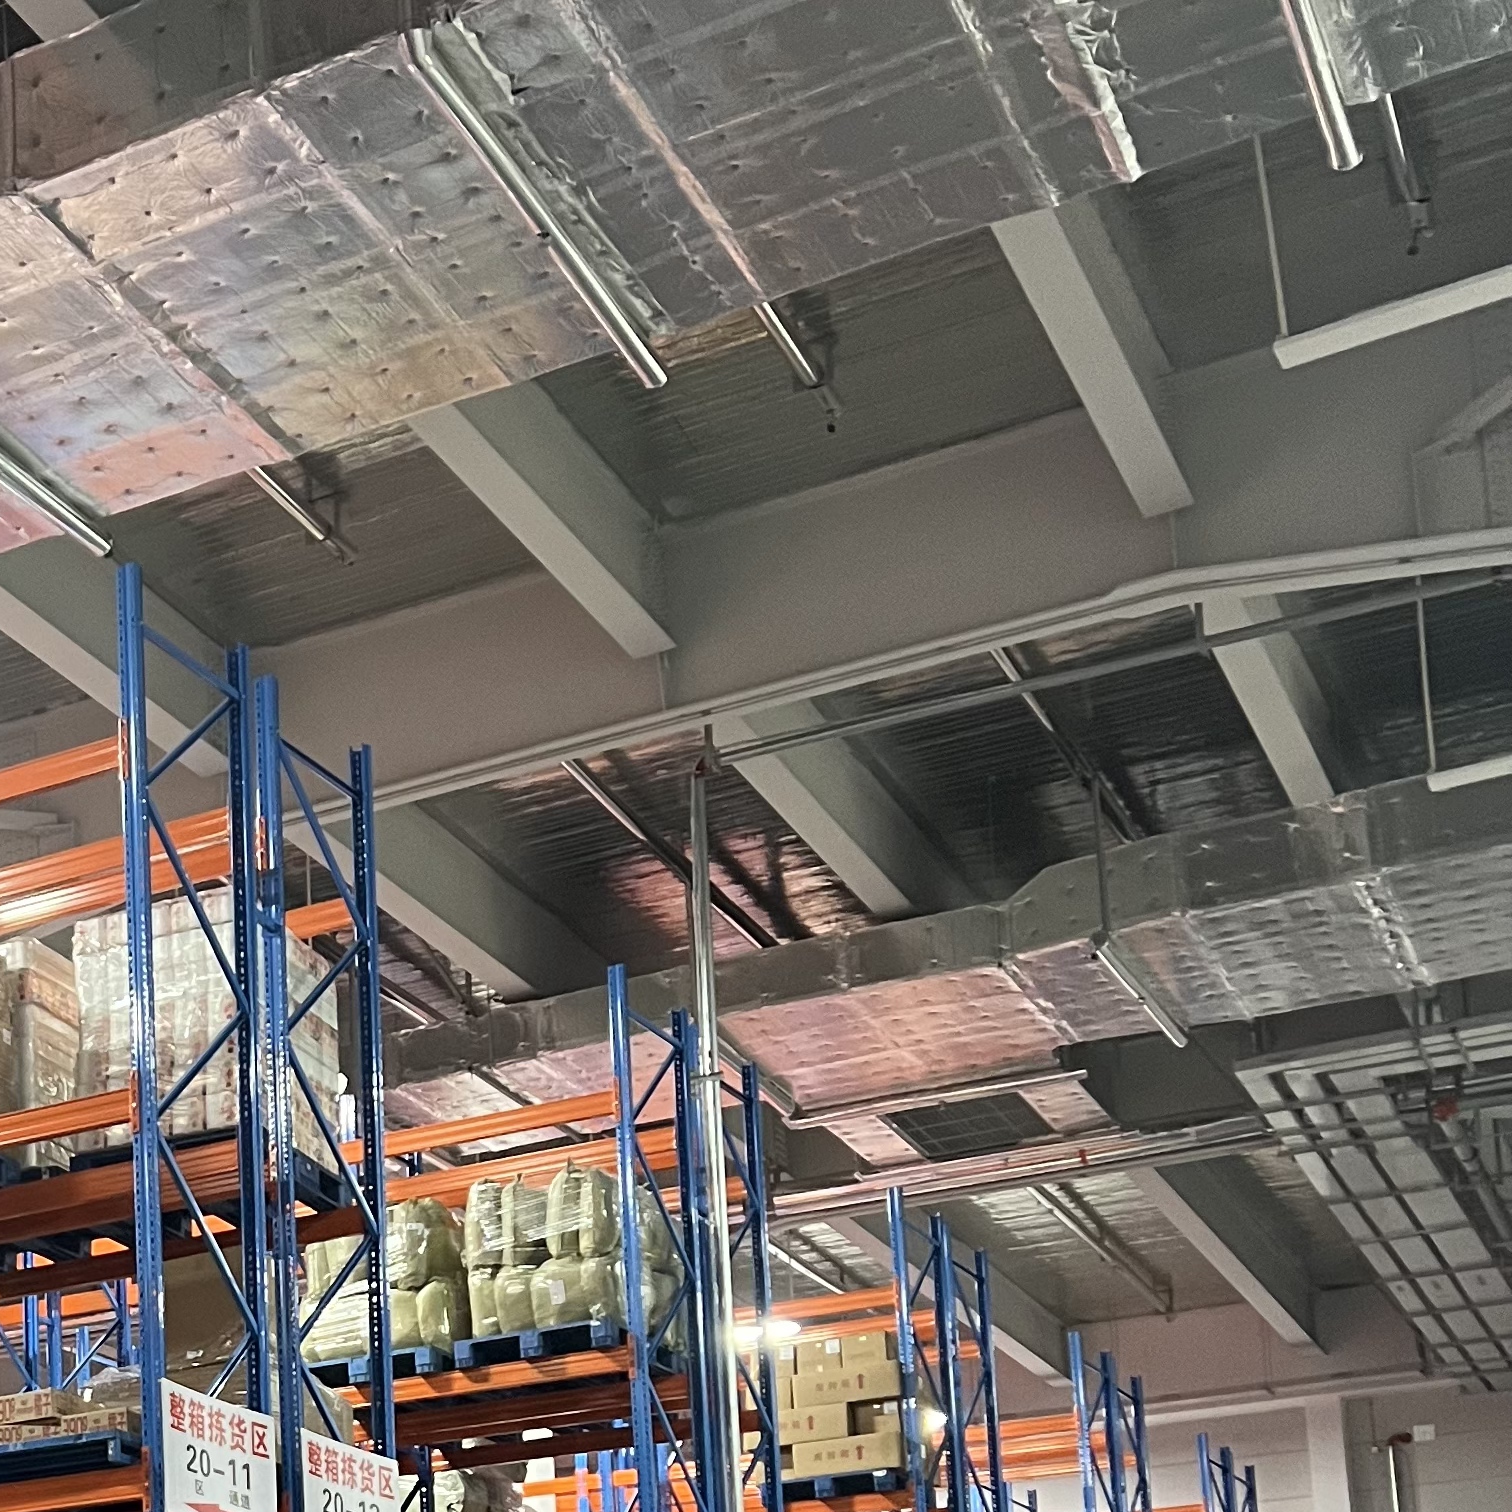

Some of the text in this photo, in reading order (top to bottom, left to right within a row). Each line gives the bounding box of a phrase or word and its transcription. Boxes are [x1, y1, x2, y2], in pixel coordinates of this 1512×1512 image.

[169, 1391, 270, 1459] 整箱拣货区
[186, 1444, 251, 1490] 20-11
[307, 1439, 395, 1500] 整箱拣货区
